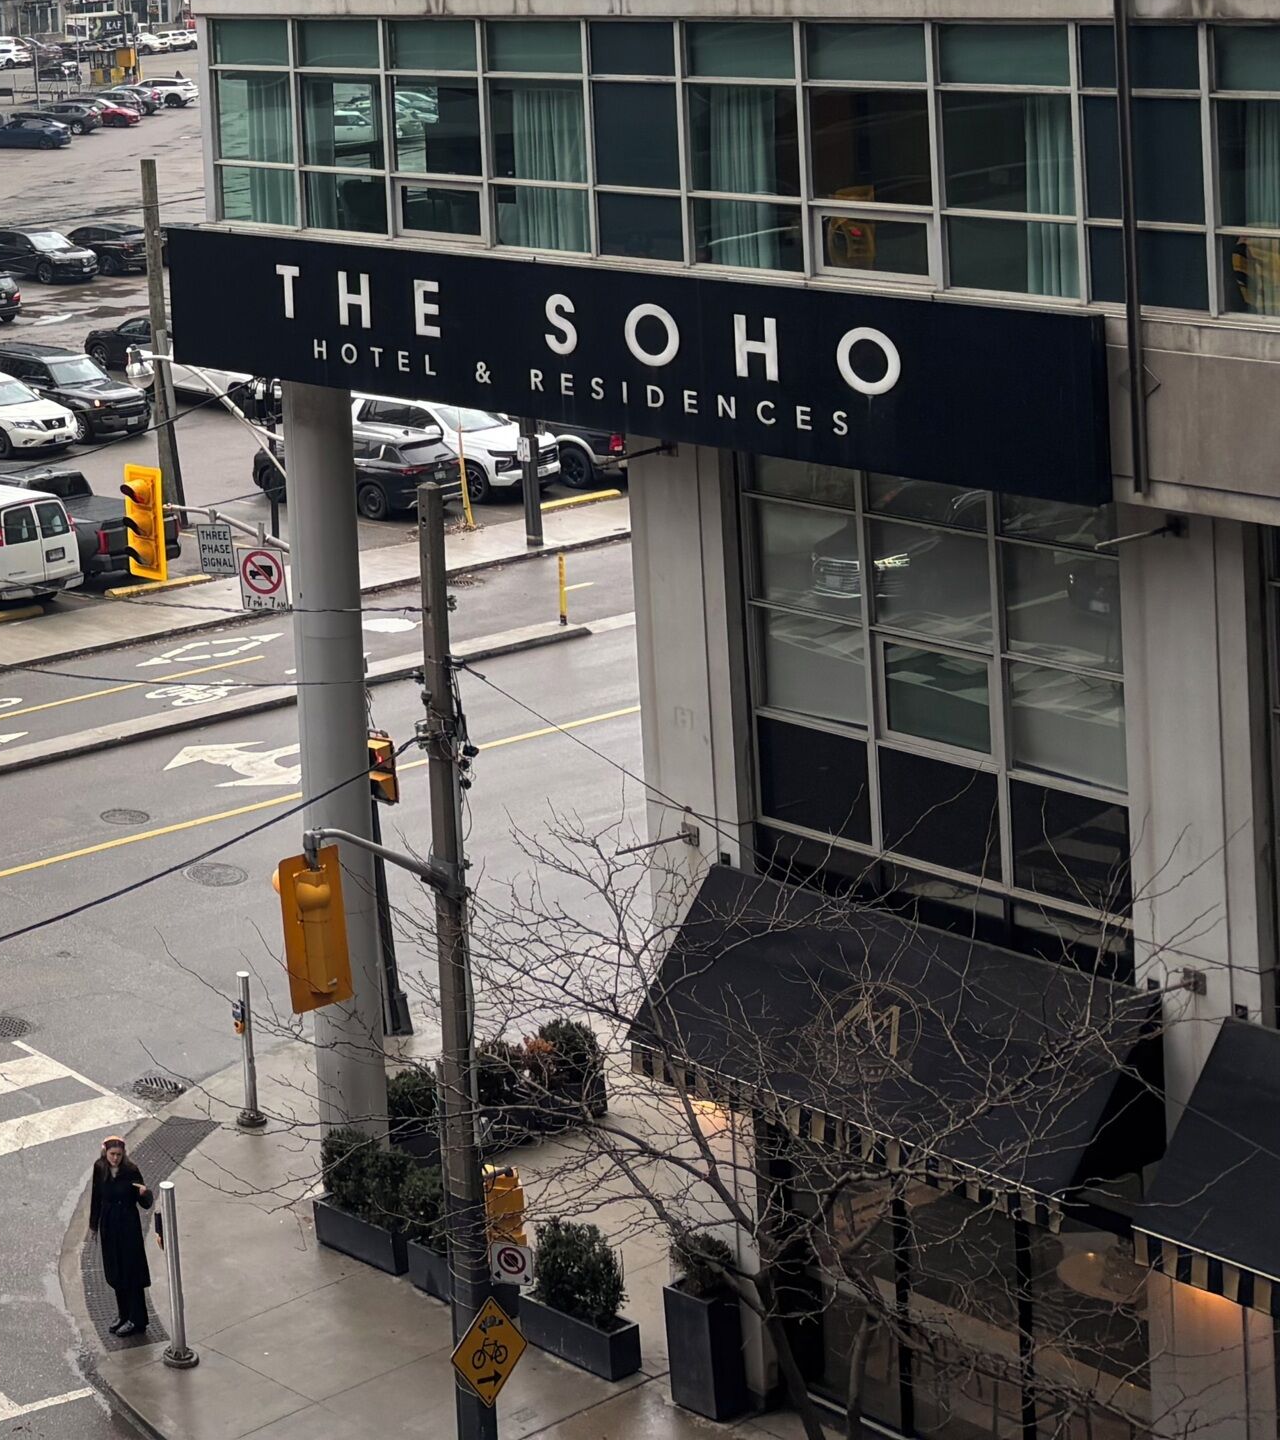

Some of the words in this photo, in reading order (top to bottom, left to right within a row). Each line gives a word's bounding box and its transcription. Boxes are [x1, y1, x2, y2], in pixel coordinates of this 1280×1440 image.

[276, 263, 441, 338] THE
[544, 293, 901, 396] SOHO
[313, 338, 437, 376] HOTEL
[475, 361, 492, 385] &
[529, 368, 849, 437] RESIDENCES
[201, 530, 229, 541] THREE
[202, 544, 231, 554] PHASE
[203, 557, 233, 568] SIGNAL
[244, 594, 252, 607] 7
[268, 596, 276, 608] 7
